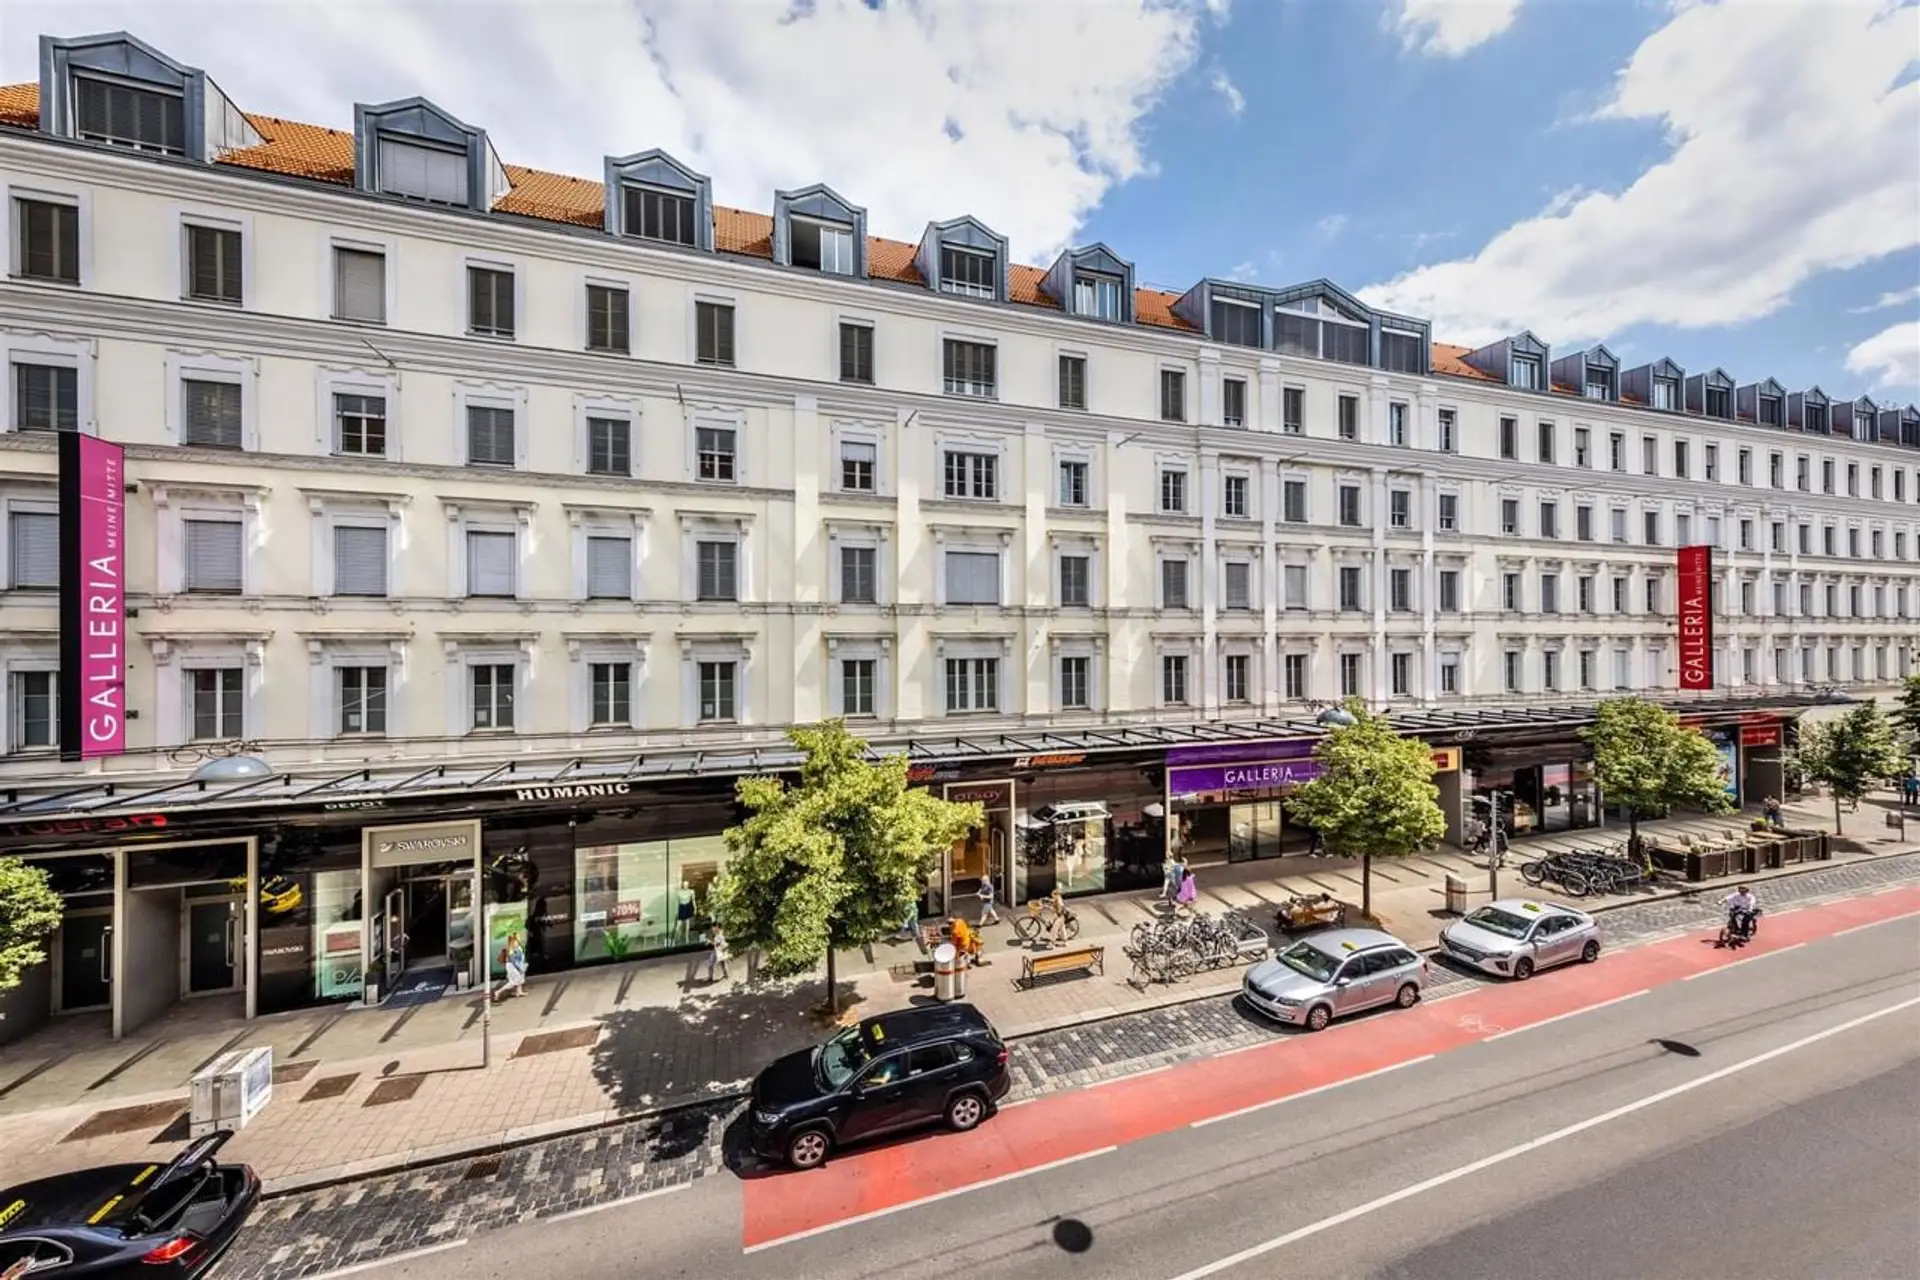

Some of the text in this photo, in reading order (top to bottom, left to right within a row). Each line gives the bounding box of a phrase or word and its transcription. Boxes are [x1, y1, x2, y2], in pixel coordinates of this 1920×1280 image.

[89, 554, 118, 742] GALLERIA
[1684, 597, 1704, 683] GALLERIA
[1225, 766, 1294, 784] GALLERIA
[515, 783, 631, 801] HUMANIC
[324, 800, 386, 811] DEPOT
[397, 835, 467, 851] SWAROVSKI
